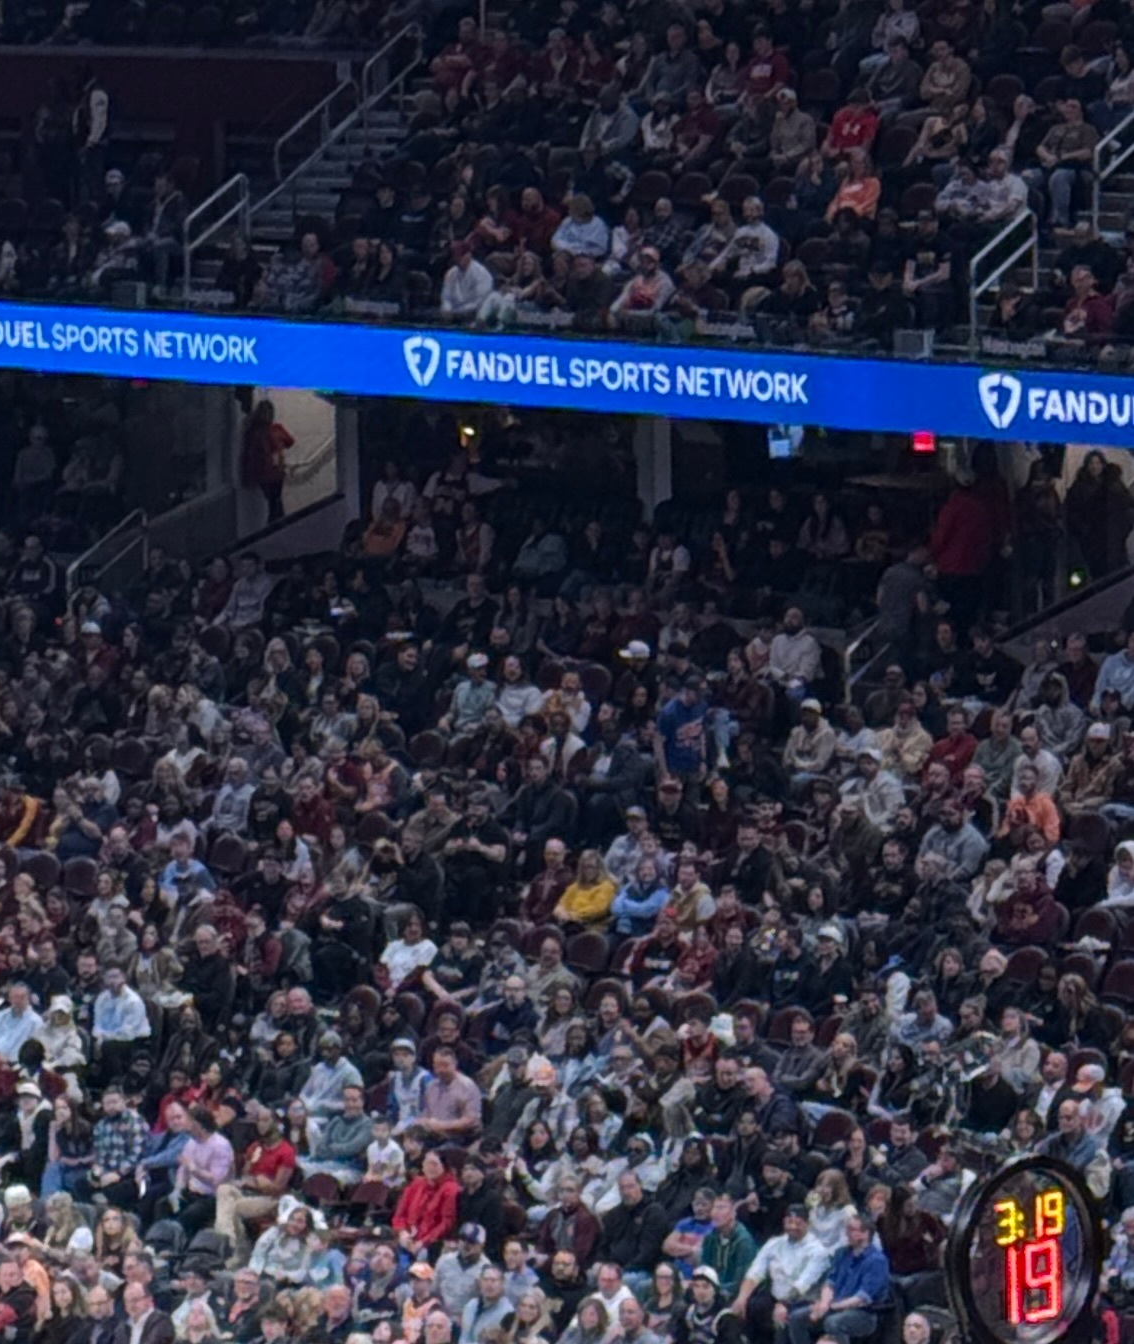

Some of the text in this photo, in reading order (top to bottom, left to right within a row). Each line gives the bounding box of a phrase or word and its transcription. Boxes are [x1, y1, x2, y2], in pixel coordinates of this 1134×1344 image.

[52, 322, 138, 357] SPORTS
[143, 330, 258, 365] NETWORK
[445, 351, 808, 405] FANDUEL SPORTS NETWORK
[1028, 387, 1134, 426] FANDU
[994, 1191, 1064, 1246] 3:19
[1005, 1238, 1064, 1324] 19
